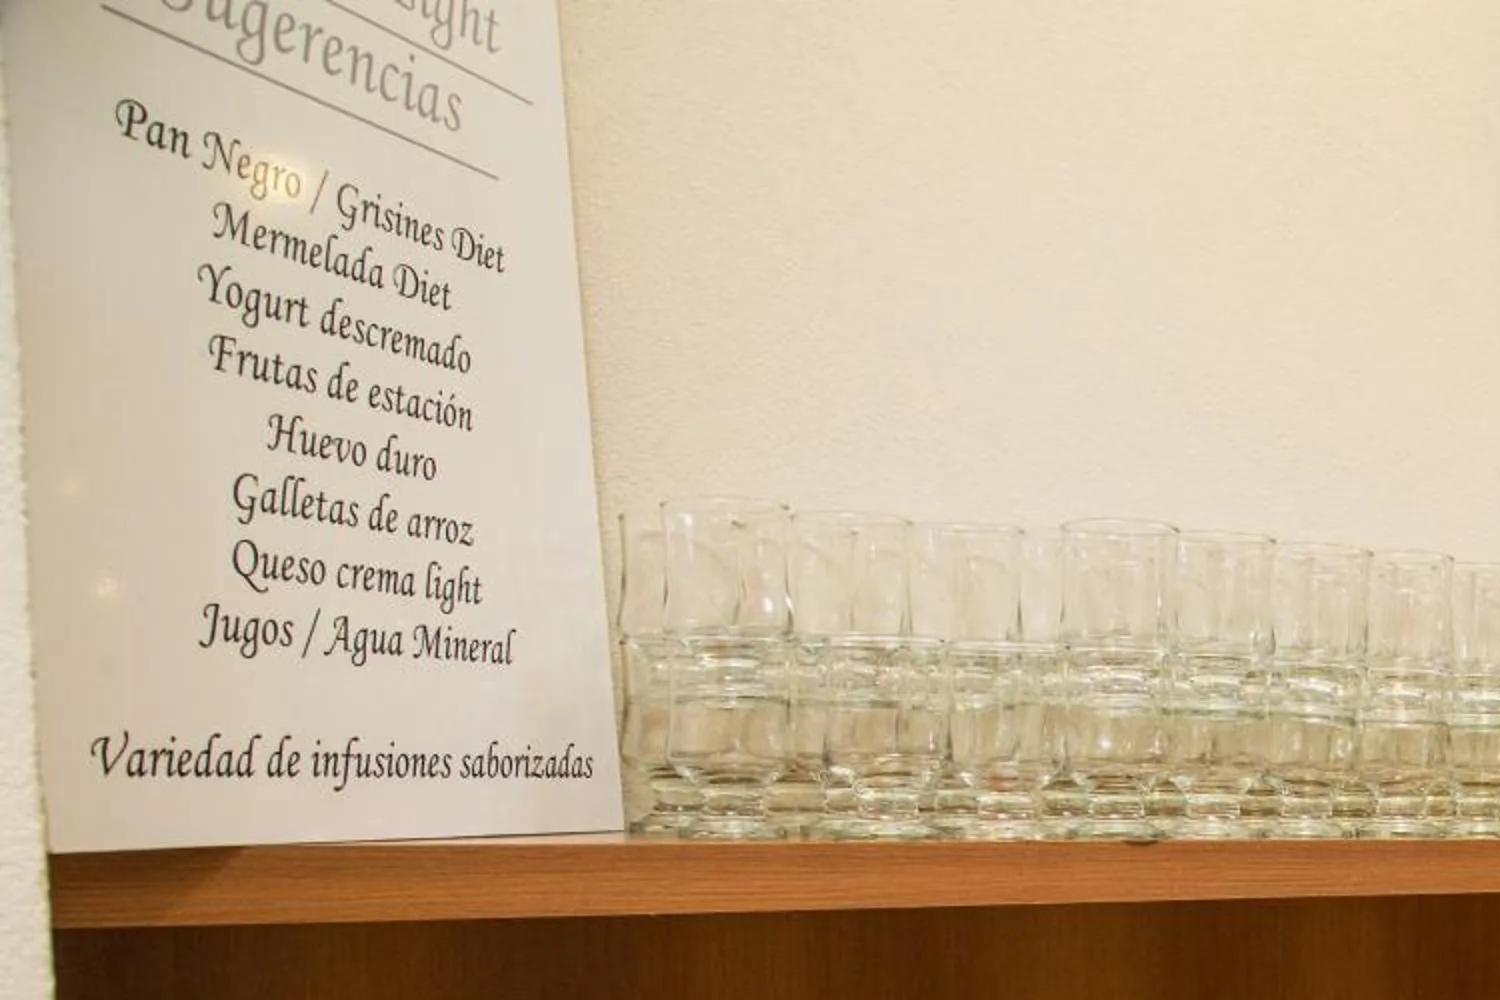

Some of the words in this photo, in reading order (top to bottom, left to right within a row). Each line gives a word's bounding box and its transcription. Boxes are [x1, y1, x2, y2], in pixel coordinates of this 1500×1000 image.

[160, 0, 462, 132] ugerencias
[115, 99, 191, 159] Pan
[202, 131, 300, 200] Negro
[310, 170, 329, 214] /
[337, 183, 444, 251] Grisines
[451, 227, 505, 273] Diet
[213, 202, 384, 289] Mermelada
[393, 264, 452, 311] Diet
[198, 263, 310, 328] Yogurt
[320, 297, 471, 374] descremado
[208, 334, 318, 394] Frutas
[327, 361, 359, 403] de
[368, 384, 473, 432] estación
[267, 413, 367, 467] Huevo
[376, 433, 437, 481] duro
[233, 473, 359, 528] Galletas
[368, 493, 398, 534] de
[407, 514, 474, 547] arroz
[232, 539, 326, 594] Queso
[336, 563, 416, 597] crema
[425, 561, 483, 615] light
[198, 603, 294, 659] Jugos
[301, 608, 321, 659] /
[323, 616, 404, 667] Agua
[412, 624, 515, 666] Mineral
[90, 730, 262, 778] Variedad
[267, 734, 301, 778] de
[311, 736, 452, 792] infusiones
[459, 740, 593, 779] saborizadas
